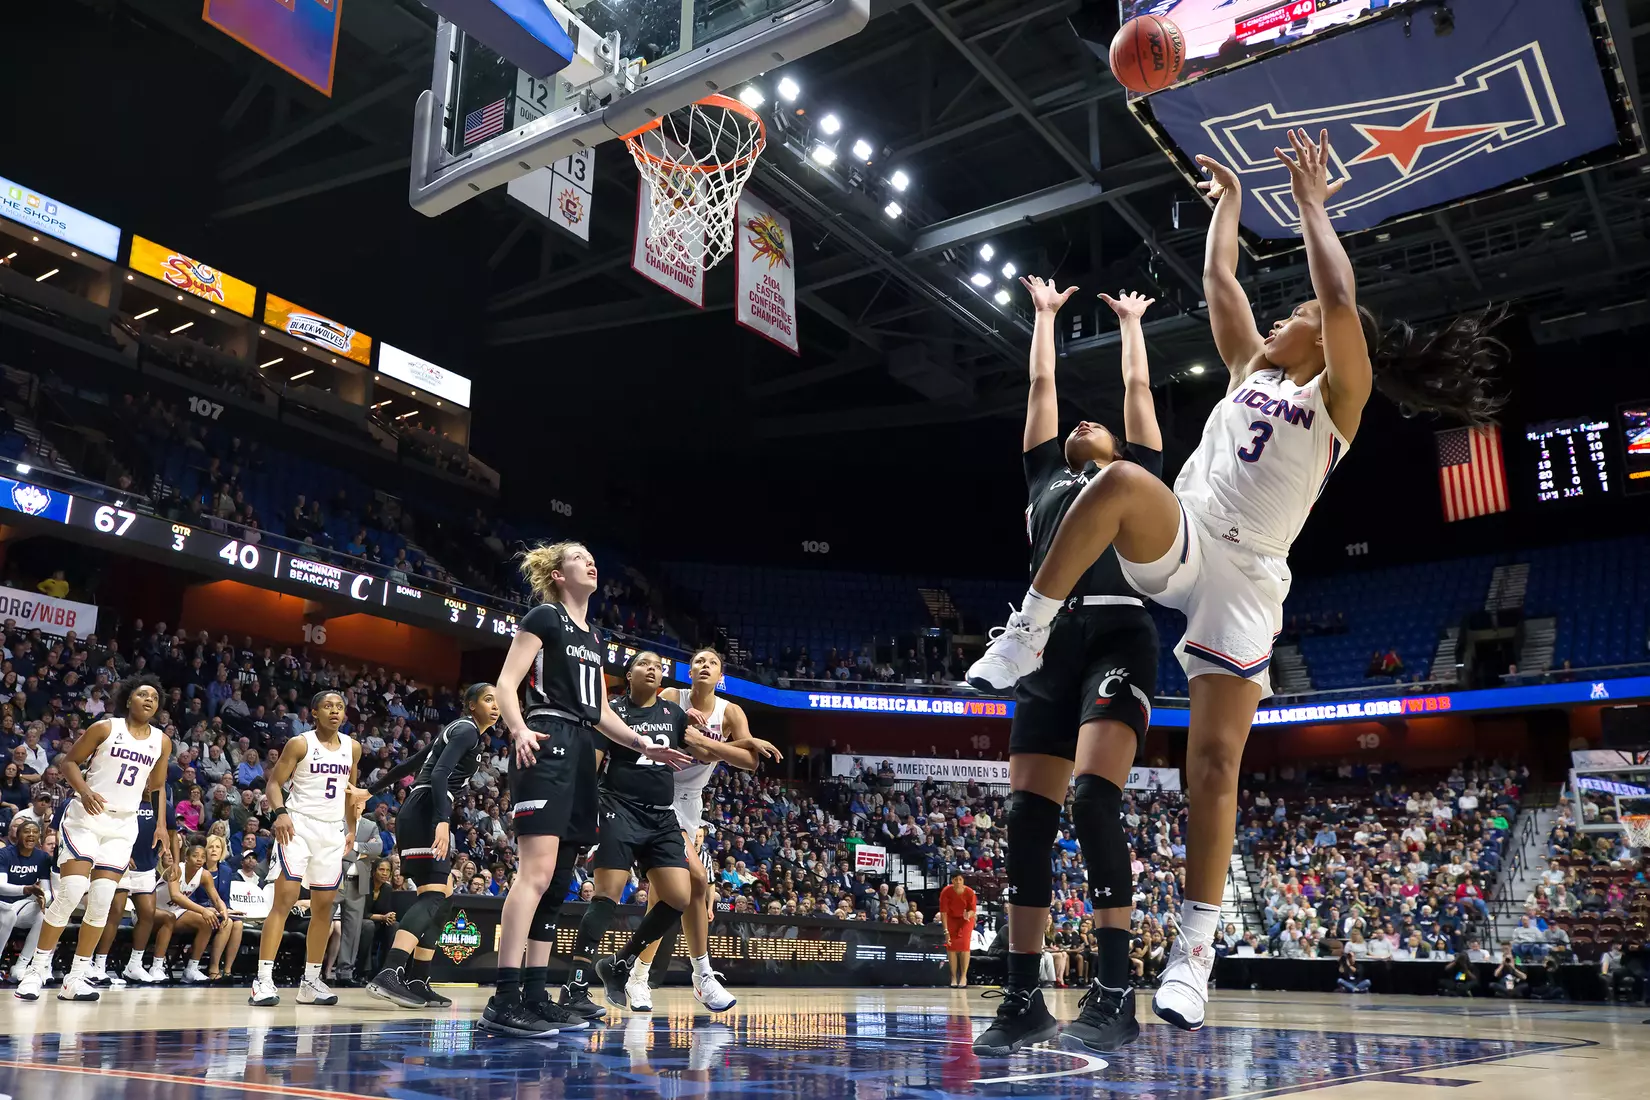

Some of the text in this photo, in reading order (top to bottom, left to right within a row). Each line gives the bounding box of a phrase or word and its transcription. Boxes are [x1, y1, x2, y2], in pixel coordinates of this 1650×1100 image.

[1292, 1, 1312, 15] 40
[527, 77, 548, 109] 12
[566, 154, 586, 182] 13
[0, 196, 66, 230] HE SHOPS
[646, 251, 695, 289] CHAMPIONS
[756, 283, 786, 308] EASTERN
[749, 290, 792, 326] CONFERENCE
[751, 304, 792, 337] CHAMPIONS
[188, 396, 224, 420] 107
[1232, 388, 1315, 431] UCONN
[1237, 420, 1273, 463] 3
[550, 498, 572, 517] 108
[93, 505, 136, 536] 67
[171, 524, 191, 537] QTR
[1221, 533, 1241, 544] UCONN
[171, 534, 185, 552] 3
[801, 540, 830, 554] 109
[1345, 542, 1368, 557] 111
[219, 540, 259, 570] 40
[289, 558, 341, 580] CINCINNATI
[289, 568, 340, 590] BEARCATS
[396, 585, 422, 599] BONUS
[444, 598, 467, 611] FOULS
[476, 606, 487, 616] TO
[449, 608, 459, 623] 3
[475, 615, 485, 629] 7
[506, 615, 516, 624] FG
[302, 623, 327, 645] 16
[606, 643, 618, 652] AST
[607, 650, 616, 664] 8
[579, 663, 597, 708] 11
[808, 694, 1006, 716] THEAMERICAN.ORG/WBB
[970, 734, 991, 750] 18
[1356, 732, 1379, 749] 19
[110, 746, 155, 767] UCONN
[116, 763, 139, 787] 13
[896, 763, 950, 777] AMERICAN
[951, 766, 998, 779] WOMEN'S
[324, 777, 338, 800] 5
[857, 851, 885, 867] ESPN
[10, 865, 38, 874] UCONN
[716, 902, 731, 911] POSS
[441, 933, 478, 945] FINAL FOUR
